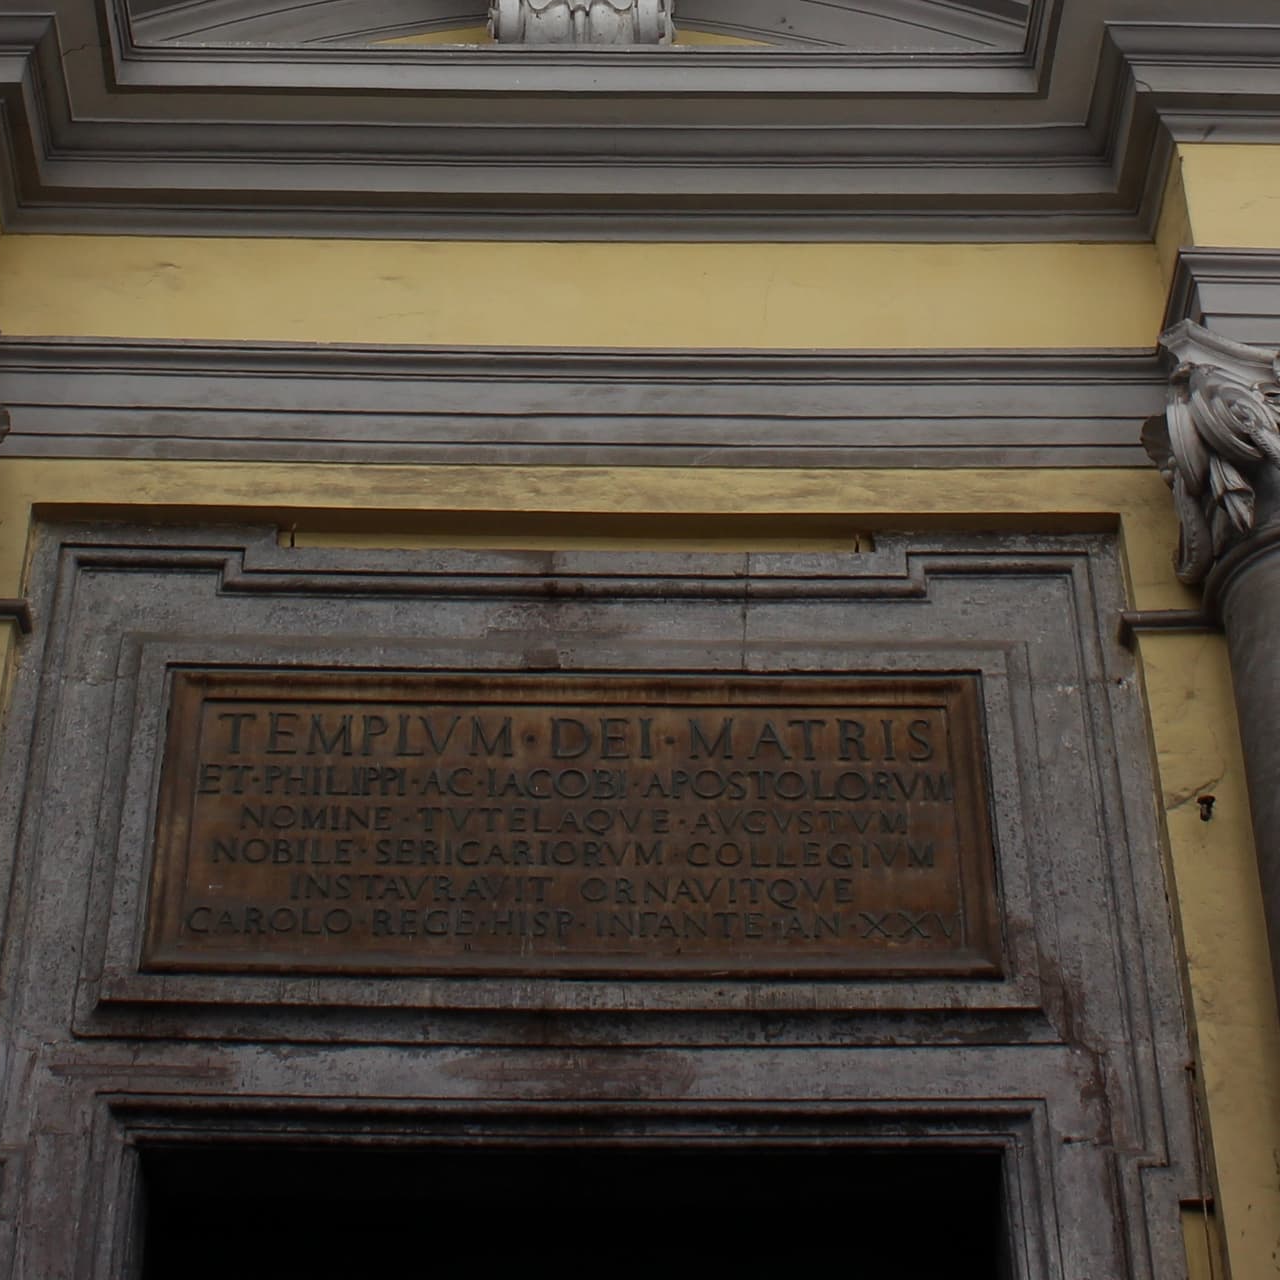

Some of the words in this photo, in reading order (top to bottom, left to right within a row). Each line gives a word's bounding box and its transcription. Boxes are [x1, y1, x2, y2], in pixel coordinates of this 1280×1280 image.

[218, 712, 515, 757] TEMPLVM
[551, 717, 653, 759] DEI
[688, 718, 934, 761] MATRIS
[197, 764, 253, 795] ET
[264, 766, 406, 796] PHILIPPI
[419, 767, 475, 797] AC
[487, 767, 626, 799] IACOBI
[642, 769, 953, 801] APOSTOLORVM
[240, 805, 393, 831] NOMINE
[210, 838, 353, 865] NOBILE
[686, 842, 934, 869] COLLEGIVM
[289, 873, 553, 902] INSTAVRAVIT
[580, 877, 854, 909] ORNAVITQVE
[185, 906, 353, 935] CAROLO
